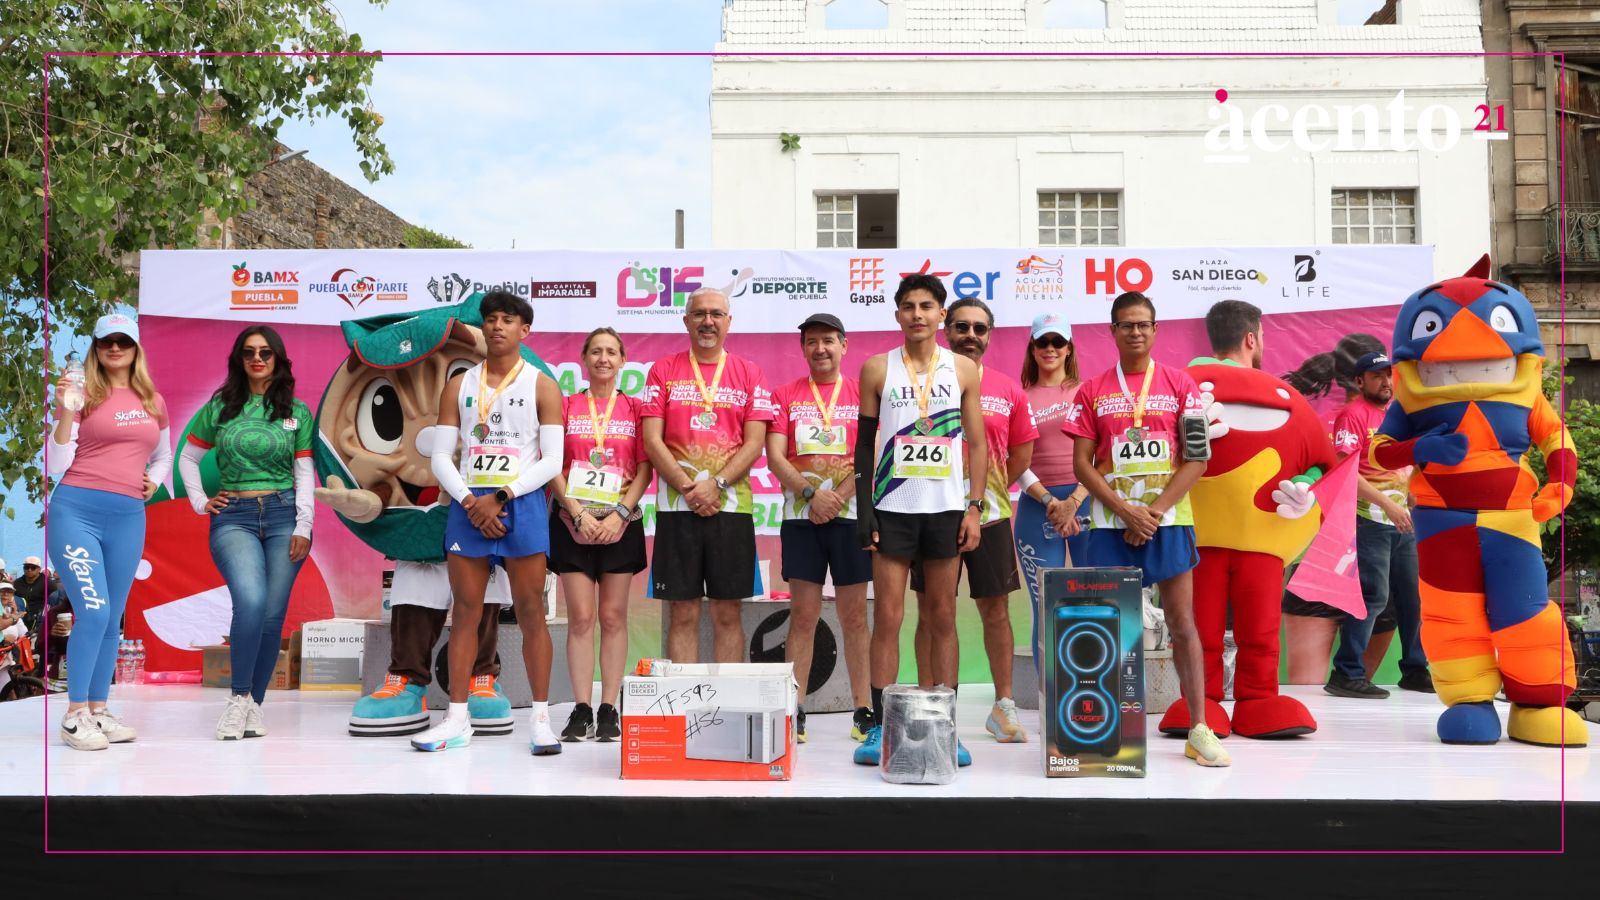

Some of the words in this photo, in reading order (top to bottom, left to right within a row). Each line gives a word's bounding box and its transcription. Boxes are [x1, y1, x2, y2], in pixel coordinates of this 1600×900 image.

[253, 271, 299, 283] BAMX
[1085, 258, 1153, 295] HO
[1172, 269, 1203, 281] SAN
[1209, 269, 1259, 281] DIEGO
[309, 283, 349, 293] PUEBLA
[474, 282, 529, 295] Puebla
[617, 266, 704, 307] DIF
[752, 282, 828, 293] DEPORTE
[1016, 284, 1063, 293] MICHIN
[1282, 286, 1330, 298] LIFE
[245, 293, 284, 302] PUEBLA
[538, 289, 591, 297] IMPARABLE
[850, 293, 885, 306] Gapsa
[891, 401, 909, 409] SOY
[489, 430, 519, 438] ENRIQUE
[902, 445, 943, 462] 246
[1119, 440, 1161, 459] 440
[473, 455, 510, 471] 472
[585, 471, 606, 487] 21
[1076, 583, 1119, 591] KAISER
[1049, 756, 1079, 766] Bajos
